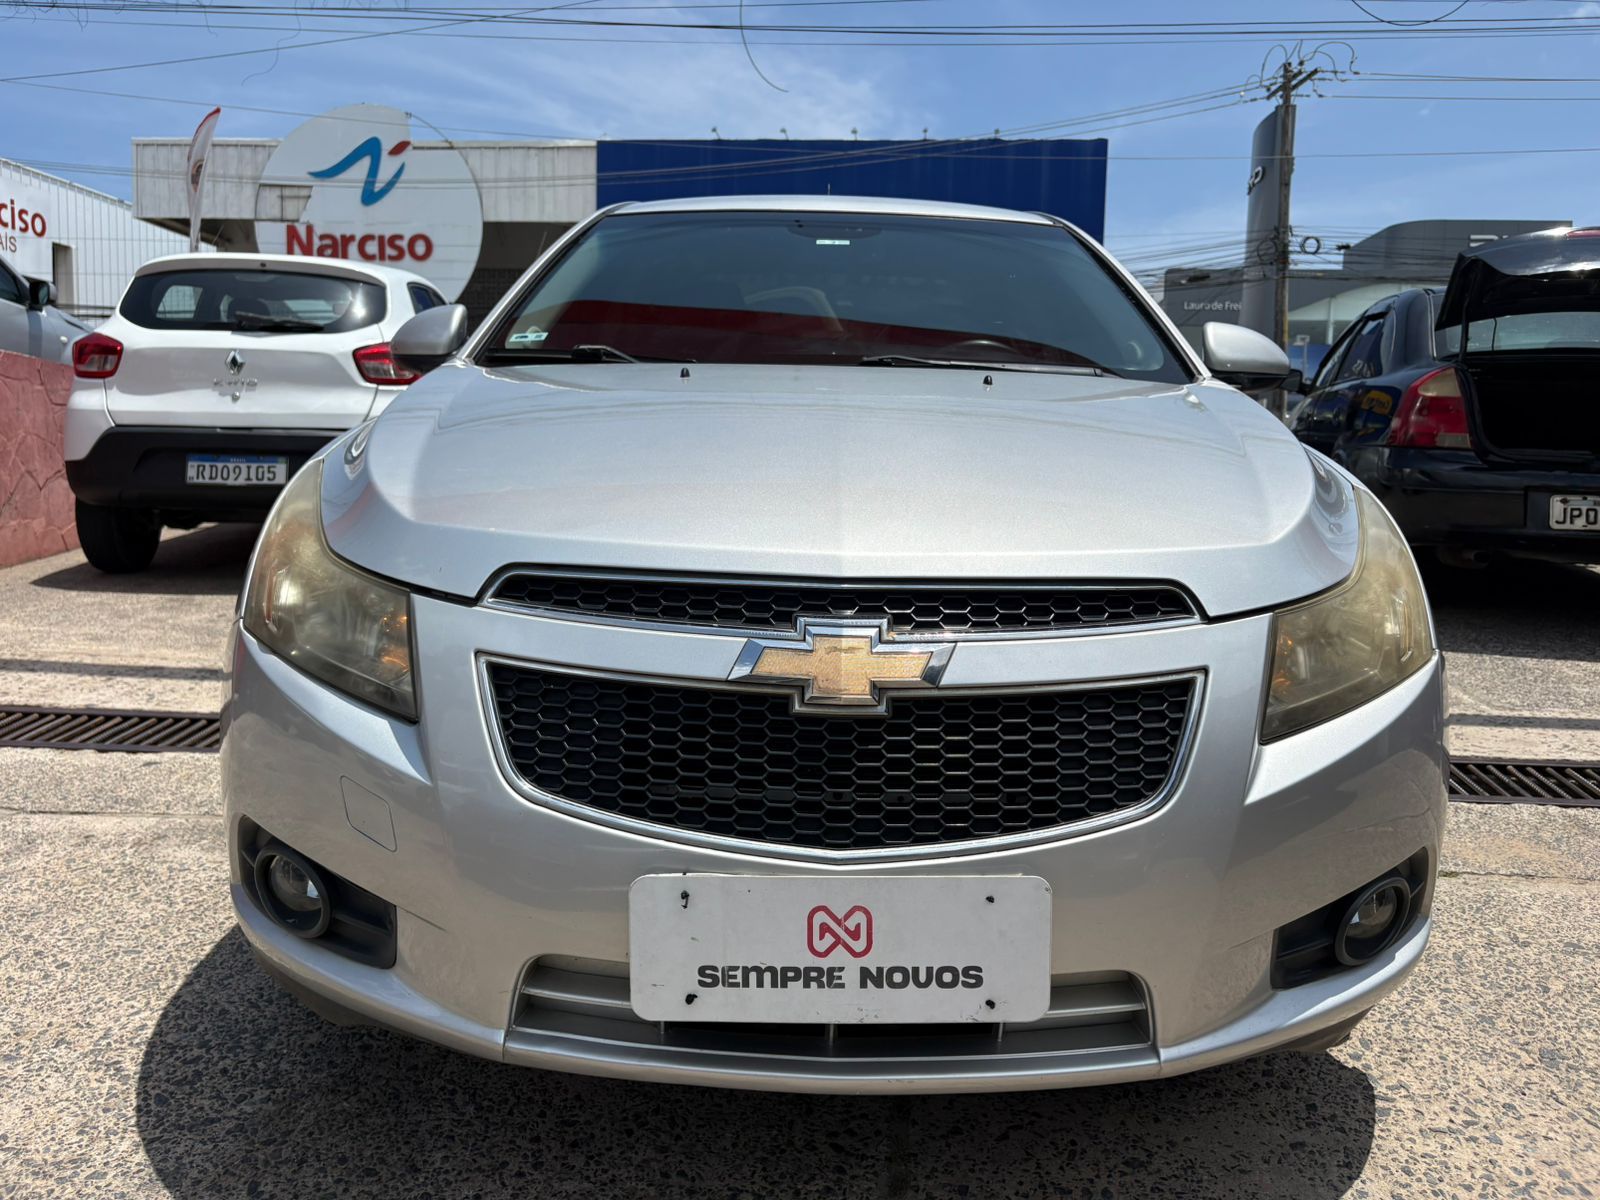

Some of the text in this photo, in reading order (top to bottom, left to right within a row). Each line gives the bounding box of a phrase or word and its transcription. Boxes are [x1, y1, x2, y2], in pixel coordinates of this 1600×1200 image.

[286, 223, 434, 261] Narciso
[1211, 301, 1224, 311] de
[697, 964, 984, 989] SEMPRE NOVOS
